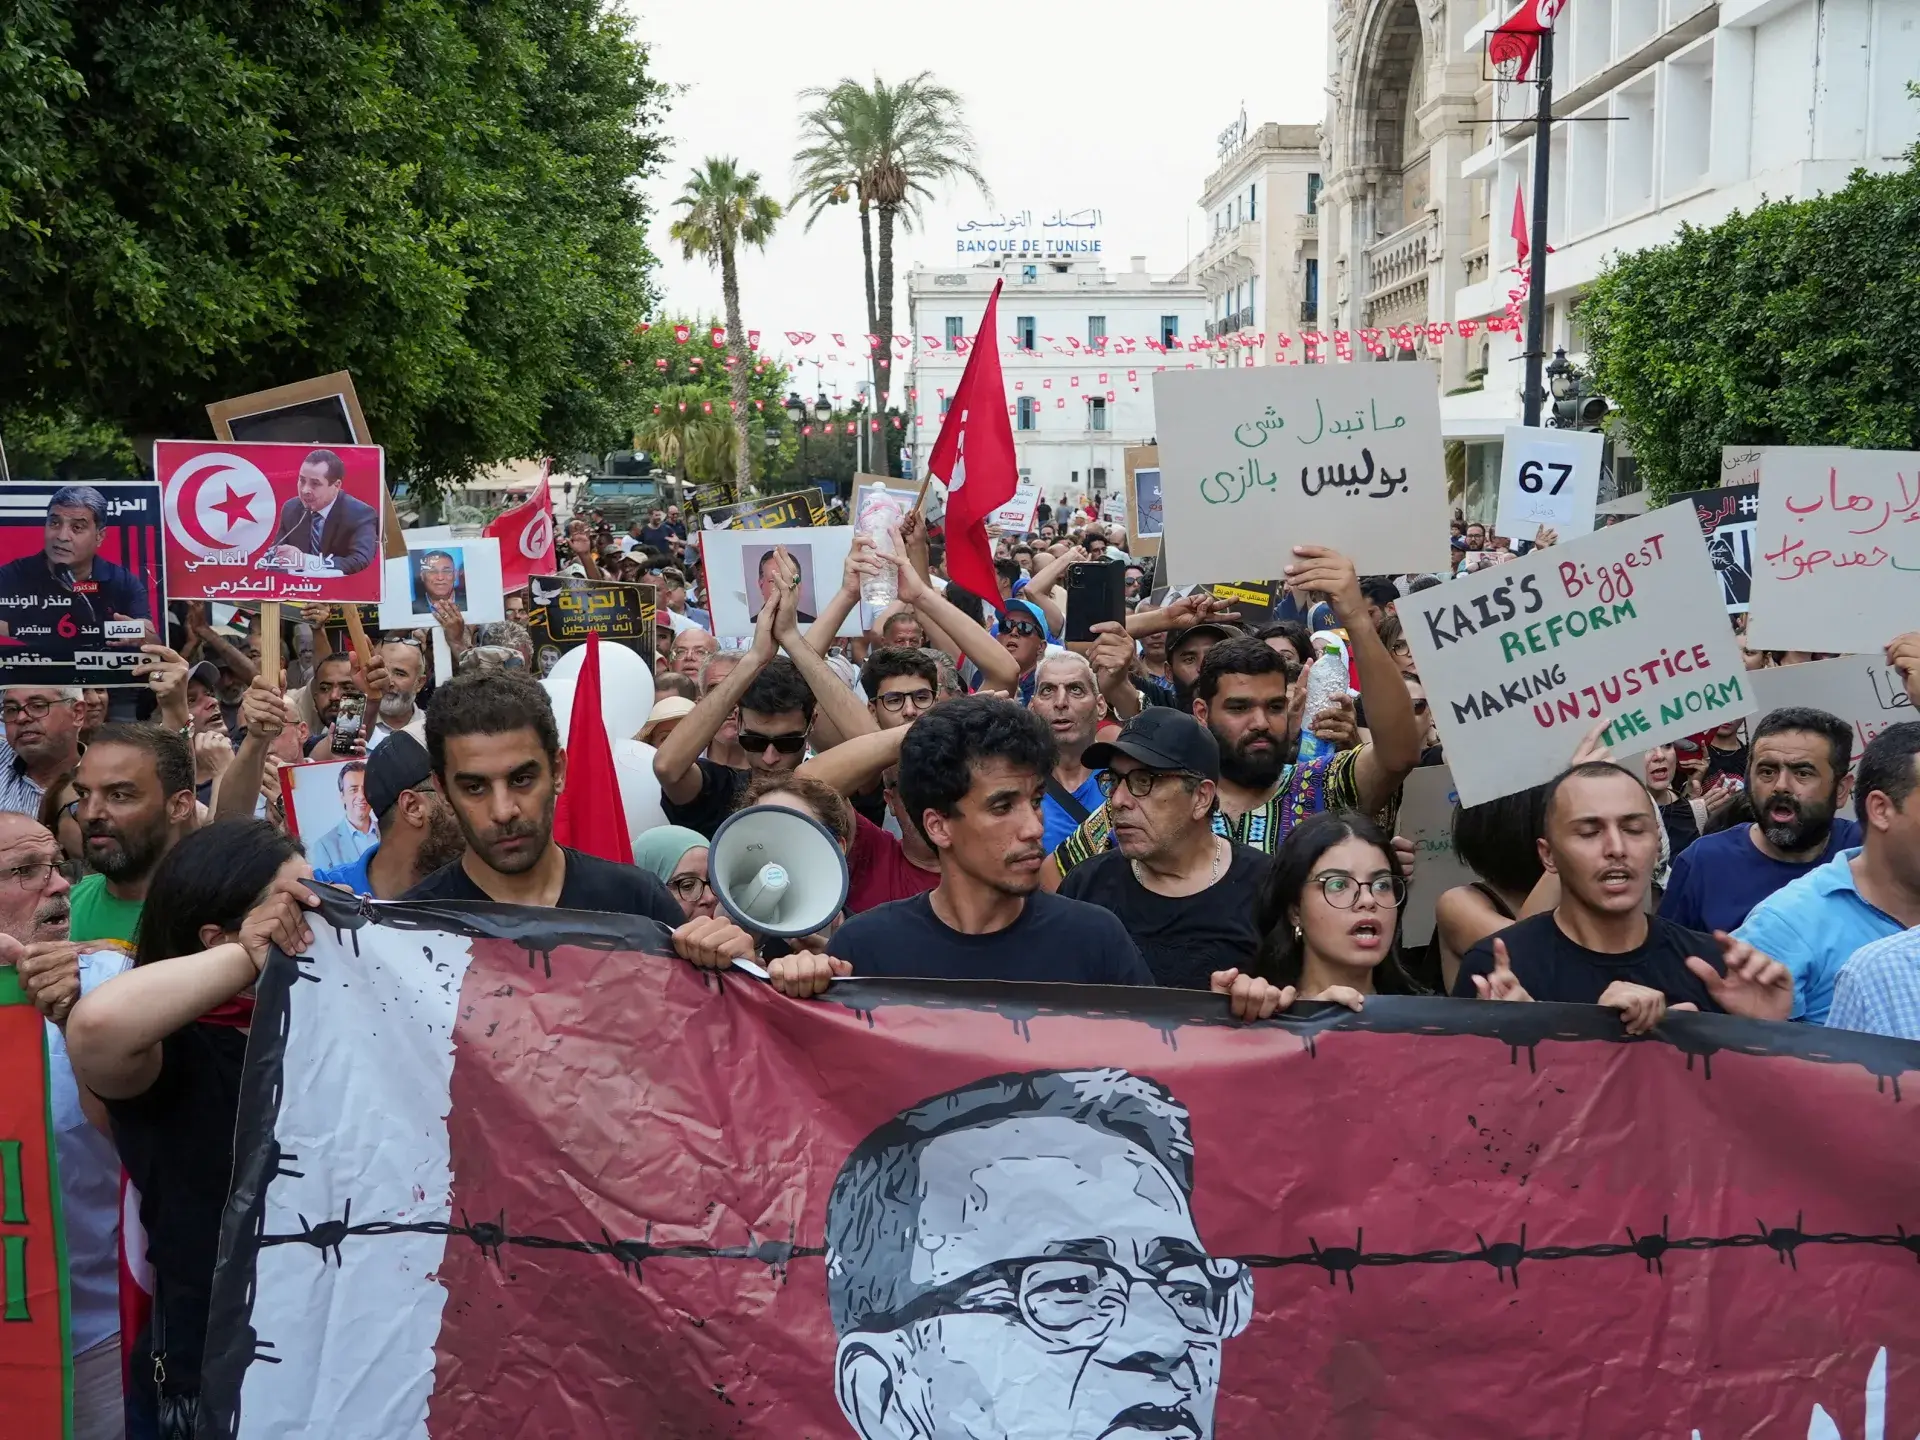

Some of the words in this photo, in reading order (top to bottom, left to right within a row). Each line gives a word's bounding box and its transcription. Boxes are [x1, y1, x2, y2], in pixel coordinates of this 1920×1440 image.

[1043, 208, 1102, 229] البنك
[957, 240, 1016, 251] BANQUE
[1023, 240, 1039, 251] DE
[1046, 240, 1101, 251] TUNISIE
[1301, 448, 1409, 498] بوليس
[1518, 460, 1573, 496] 67
[185, 550, 248, 572] للقاضي
[254, 551, 303, 570] الدعم
[311, 552, 335, 571] كل
[203, 576, 275, 597] العكرمي
[280, 577, 322, 597] بشير
[0, 594, 38, 609] الونيس
[41, 594, 72, 609] منذر
[558, 590, 625, 614] الحرية
[15, 624, 51, 636] سبتمبر
[57, 612, 77, 638] 6
[81, 625, 100, 635] منذ
[107, 625, 142, 636] معتقل
[562, 623, 608, 636] فلسطين
[612, 622, 633, 634] إلى
[1499, 599, 1638, 663] REFORM
[1450, 663, 1567, 725] MAKING
[1600, 708, 1652, 747] THE
[1659, 675, 1744, 726] NORM
